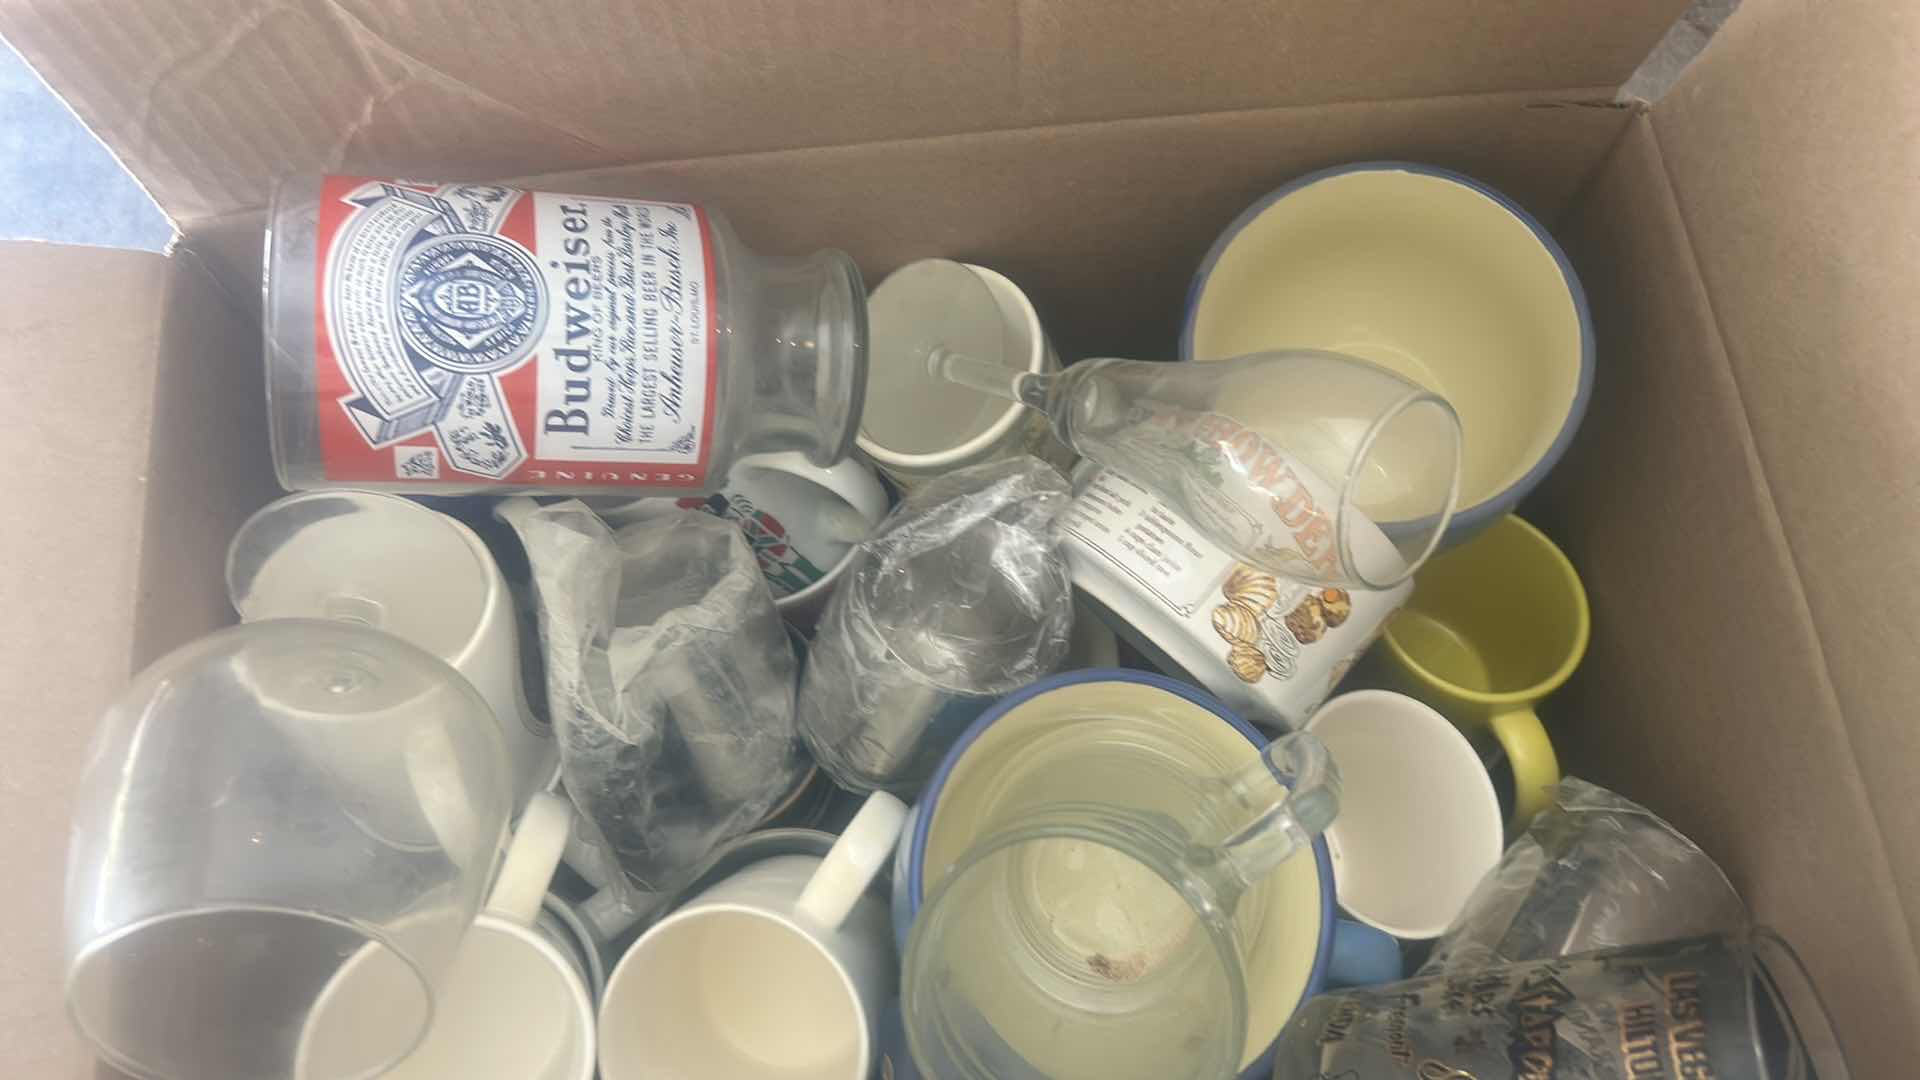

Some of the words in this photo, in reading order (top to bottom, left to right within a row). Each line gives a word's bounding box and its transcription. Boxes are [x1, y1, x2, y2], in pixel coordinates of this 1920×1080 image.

[639, 231, 654, 249] THE
[640, 254, 656, 267] IN
[591, 255, 603, 300] BEERS
[640, 270, 657, 302] BEER
[592, 303, 603, 324] OF
[592, 327, 603, 361] KING
[640, 309, 658, 361] SELLING
[640, 367, 658, 418] LARGEST
[639, 424, 655, 443] THE
[528, 470, 696, 481] GENUINE
